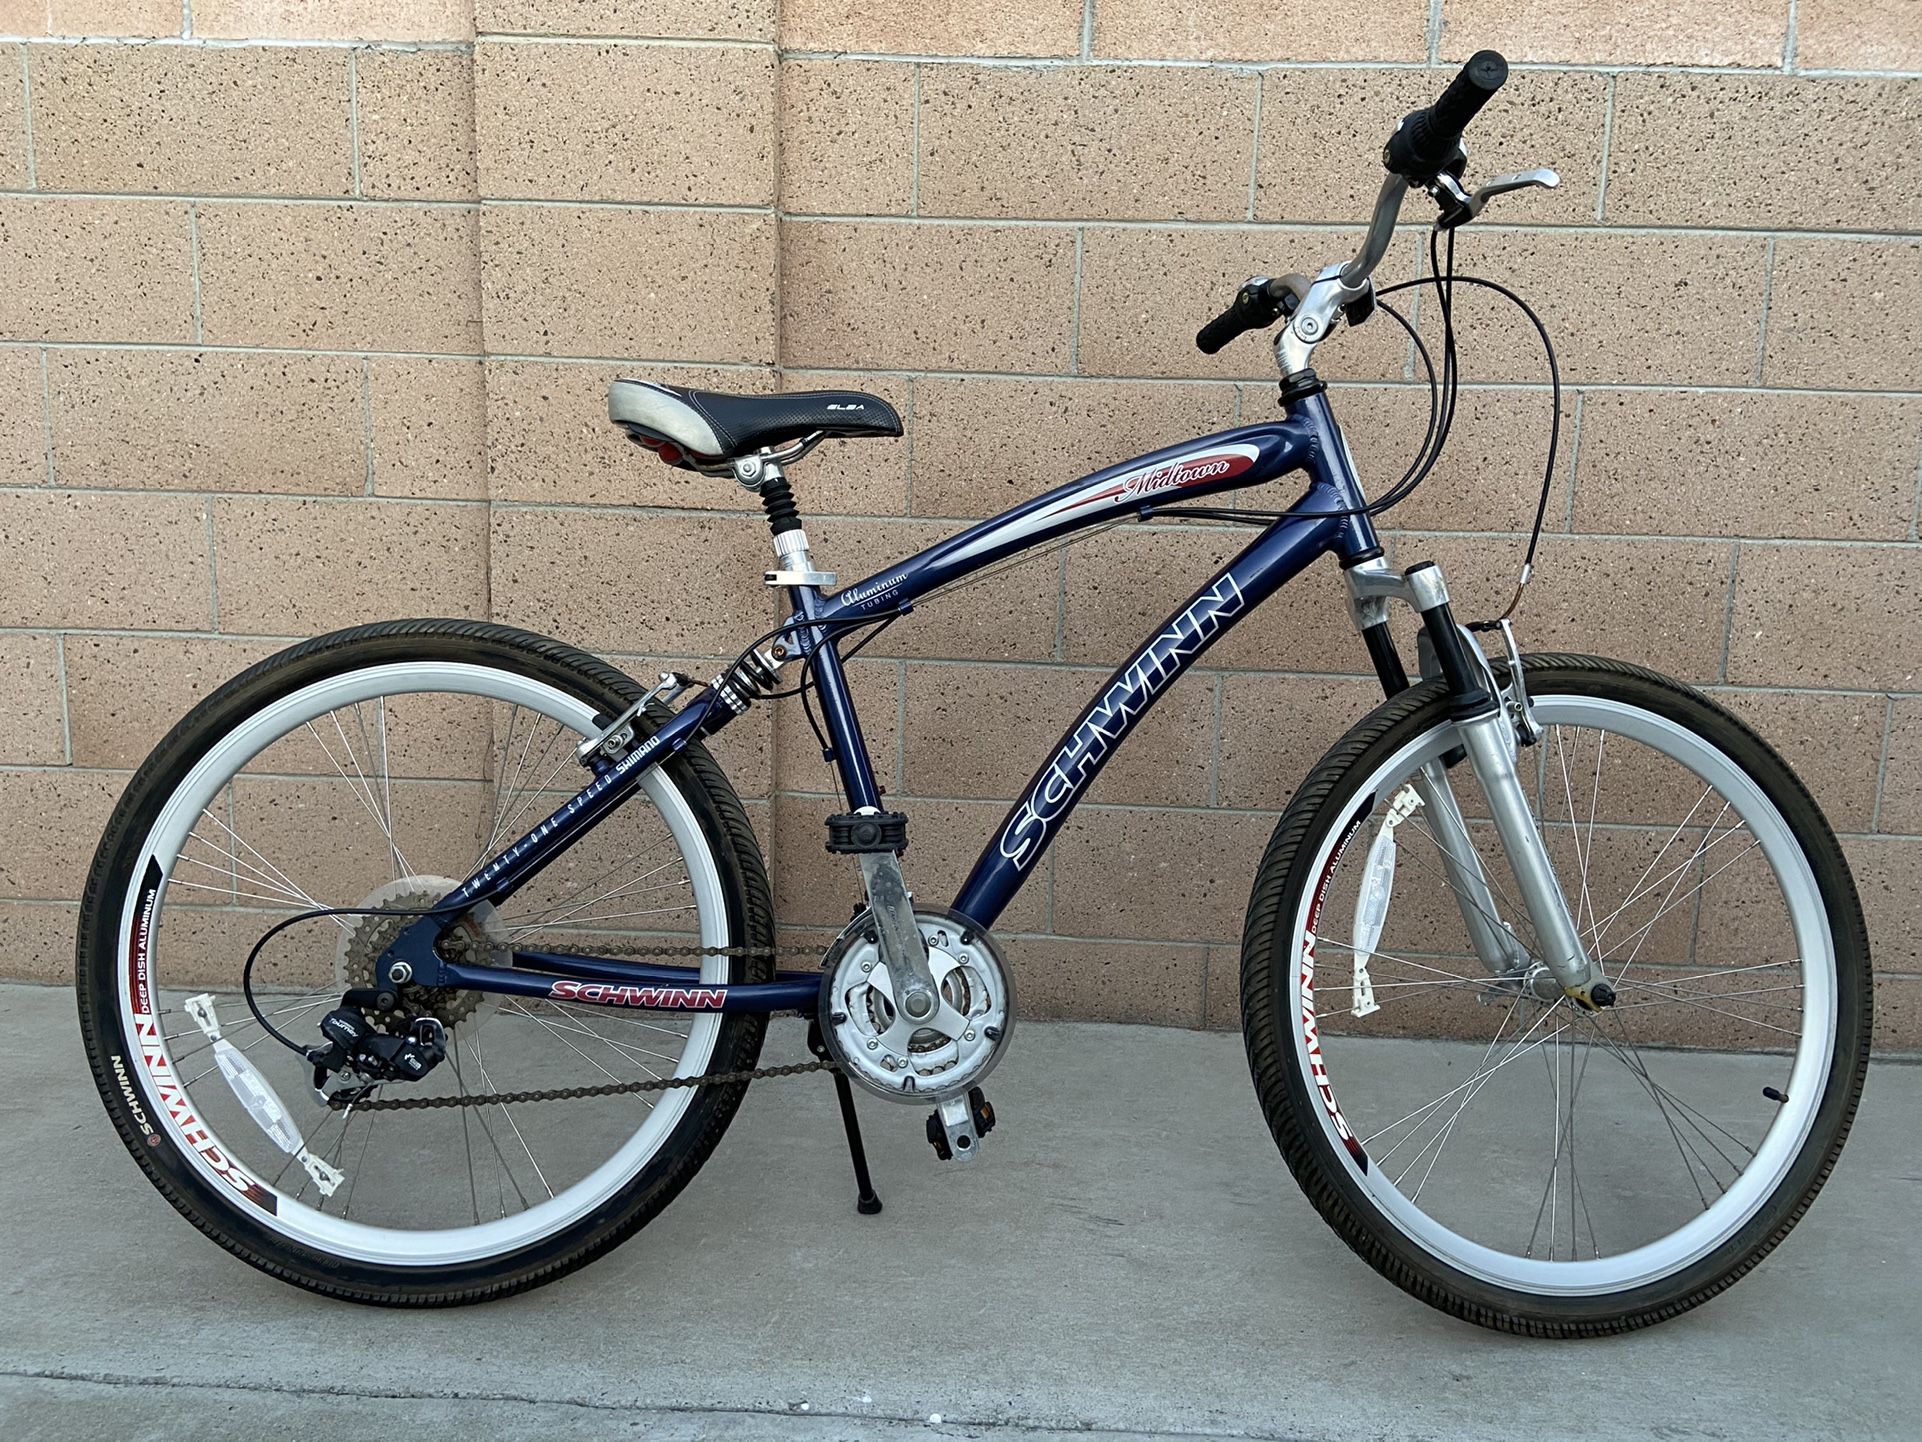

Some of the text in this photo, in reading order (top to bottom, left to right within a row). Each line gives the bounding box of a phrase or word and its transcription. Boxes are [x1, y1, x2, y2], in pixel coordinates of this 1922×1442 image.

[1113, 460, 1230, 504] Midtown
[840, 573, 909, 607] Aluminum
[861, 589, 899, 611] TUBING
[615, 735, 661, 775] SHIMANO
[1000, 572, 1245, 871] SCHWINN
[462, 774, 612, 898] TWENTY-ONE SPEED
[1311, 820, 1361, 934] DEEP DISH ALUMINUM
[137, 889, 156, 1014] DEEP DISH ALUMINUM
[548, 980, 728, 1009] SCHWINN
[1301, 930, 1353, 1141] SCHWINN
[111, 1055, 154, 1136] SCHWINN
[134, 1013, 256, 1192] SCHWINN
